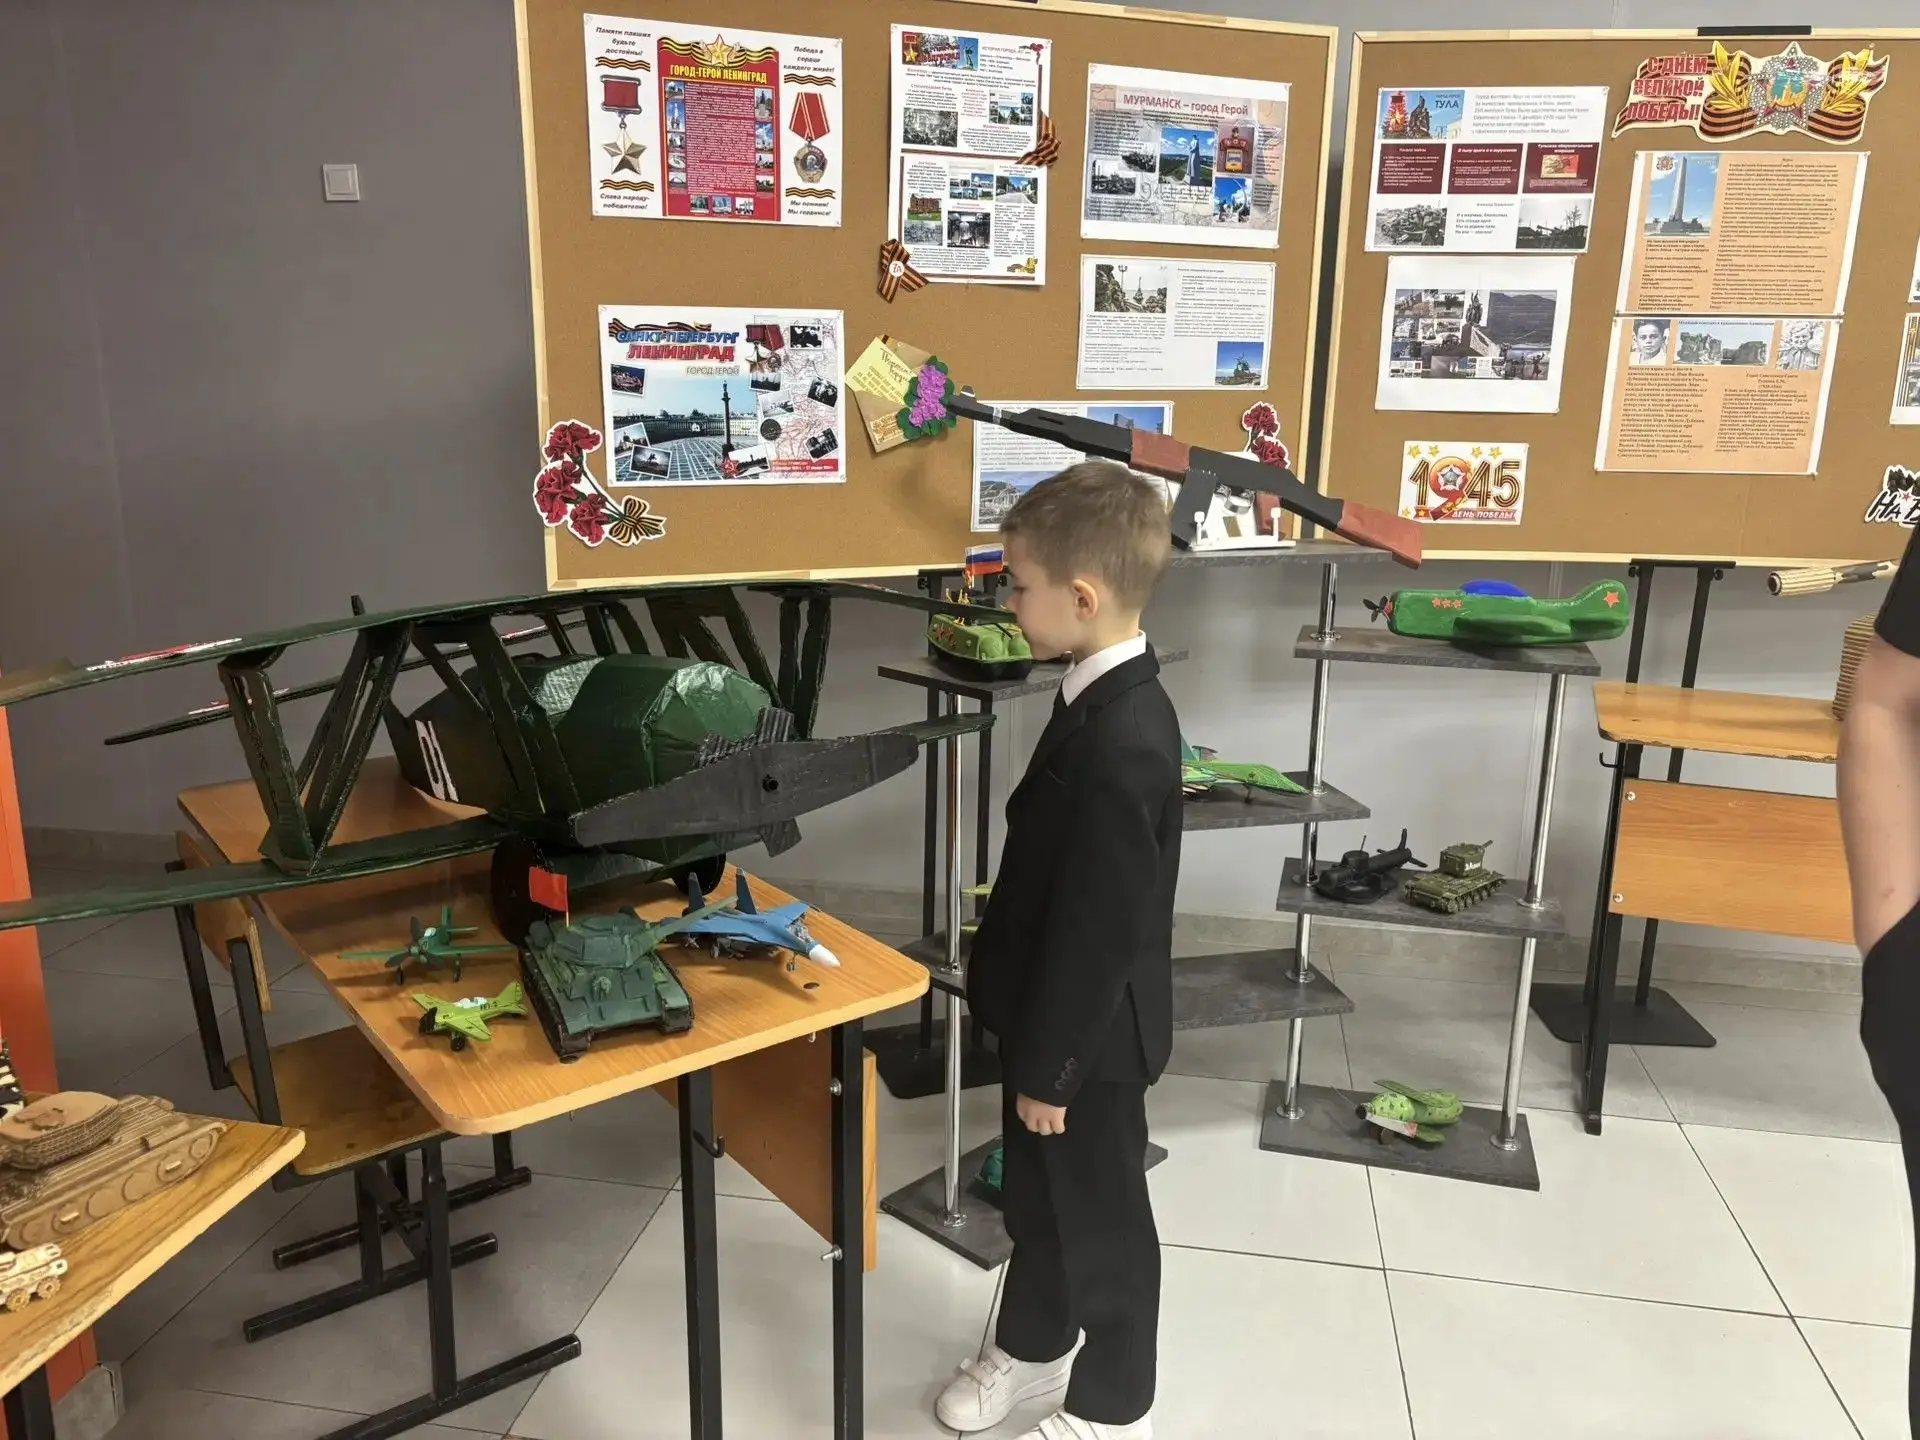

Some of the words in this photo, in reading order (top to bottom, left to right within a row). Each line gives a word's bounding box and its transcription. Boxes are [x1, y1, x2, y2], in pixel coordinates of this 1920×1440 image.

[669, 64, 722, 79] ГОРОД-ГЕРОЙ
[722, 69, 768, 84] ЛЕНИНГРАД
[1647, 57, 1657, 73] С
[1633, 77, 1704, 97] ВЕЛИКОЙ
[1123, 94, 1181, 109] МУРМАНСК
[1191, 102, 1219, 113] город
[1221, 103, 1249, 115] Герой
[1435, 100, 1460, 109] ТУЛА
[1627, 102, 1701, 122] ПОБЕДЫ!
[616, 330, 740, 344] САНКТ-ПЕТЕРБУРГ
[627, 343, 736, 363] ЛЕНИНГРАД
[1408, 456, 1520, 521] 1945
